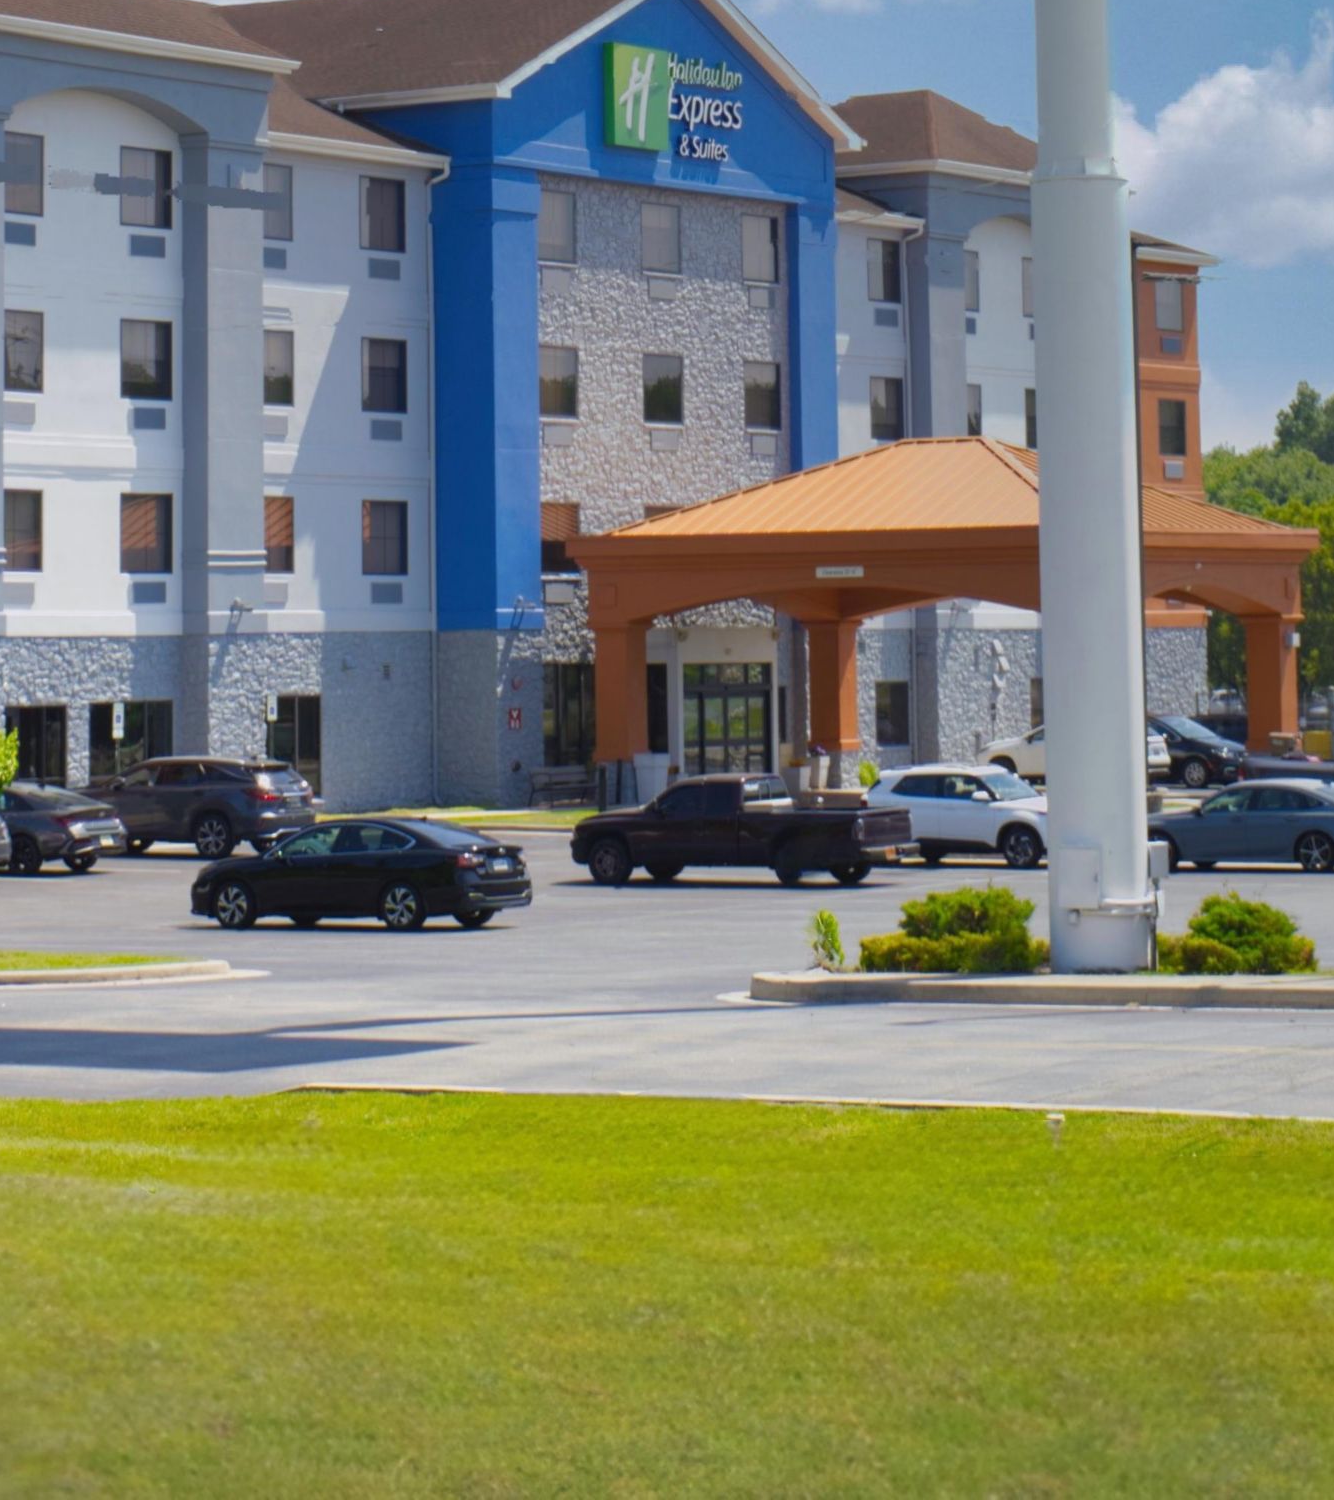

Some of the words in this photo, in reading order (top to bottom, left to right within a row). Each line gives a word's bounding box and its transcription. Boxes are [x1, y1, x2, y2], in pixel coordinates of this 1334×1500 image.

[667, 53, 722, 88] Holiday
[721, 62, 743, 91] Inn
[668, 84, 743, 132] Express
[679, 134, 690, 156] &
[692, 135, 729, 162] Suites
